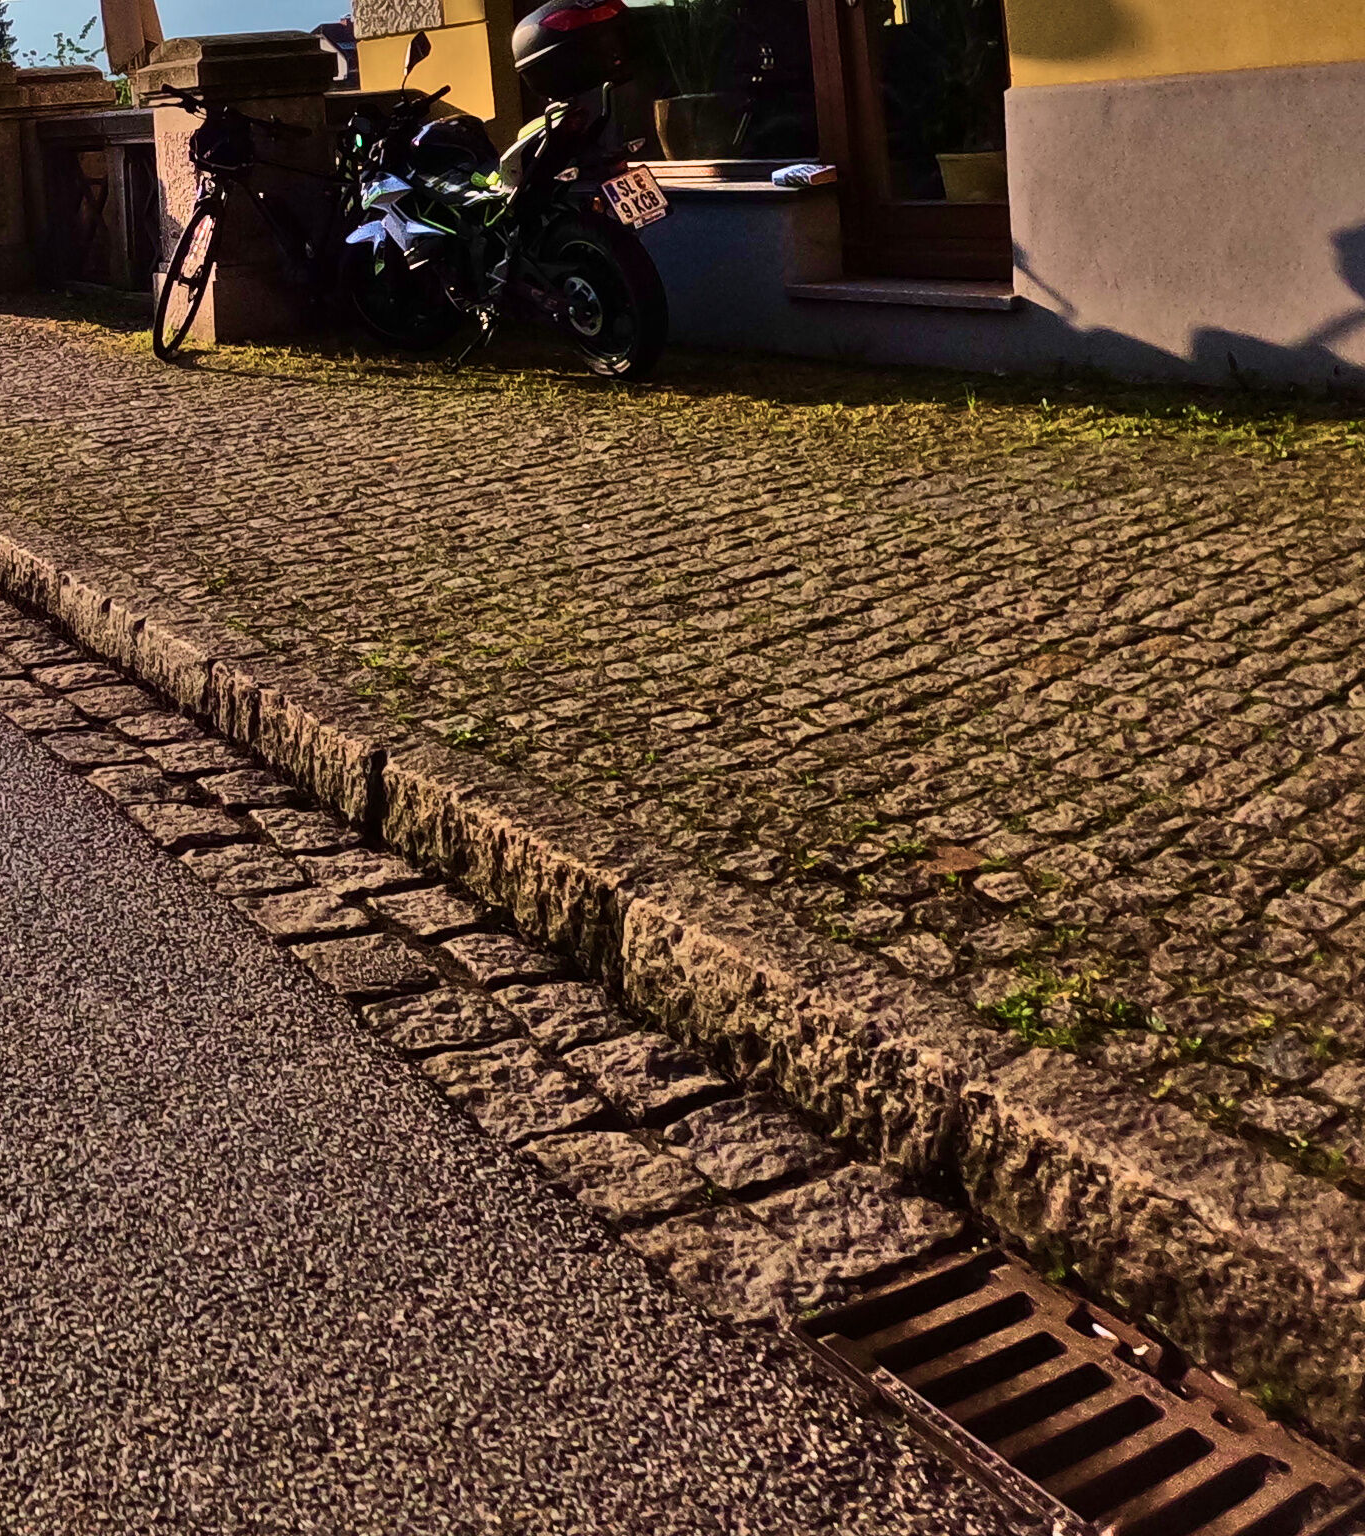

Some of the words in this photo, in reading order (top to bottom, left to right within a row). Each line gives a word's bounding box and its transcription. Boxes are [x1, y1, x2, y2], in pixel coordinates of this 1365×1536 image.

[616, 178, 636, 197] SL
[620, 202, 634, 219] 9
[630, 191, 660, 214] KCB
